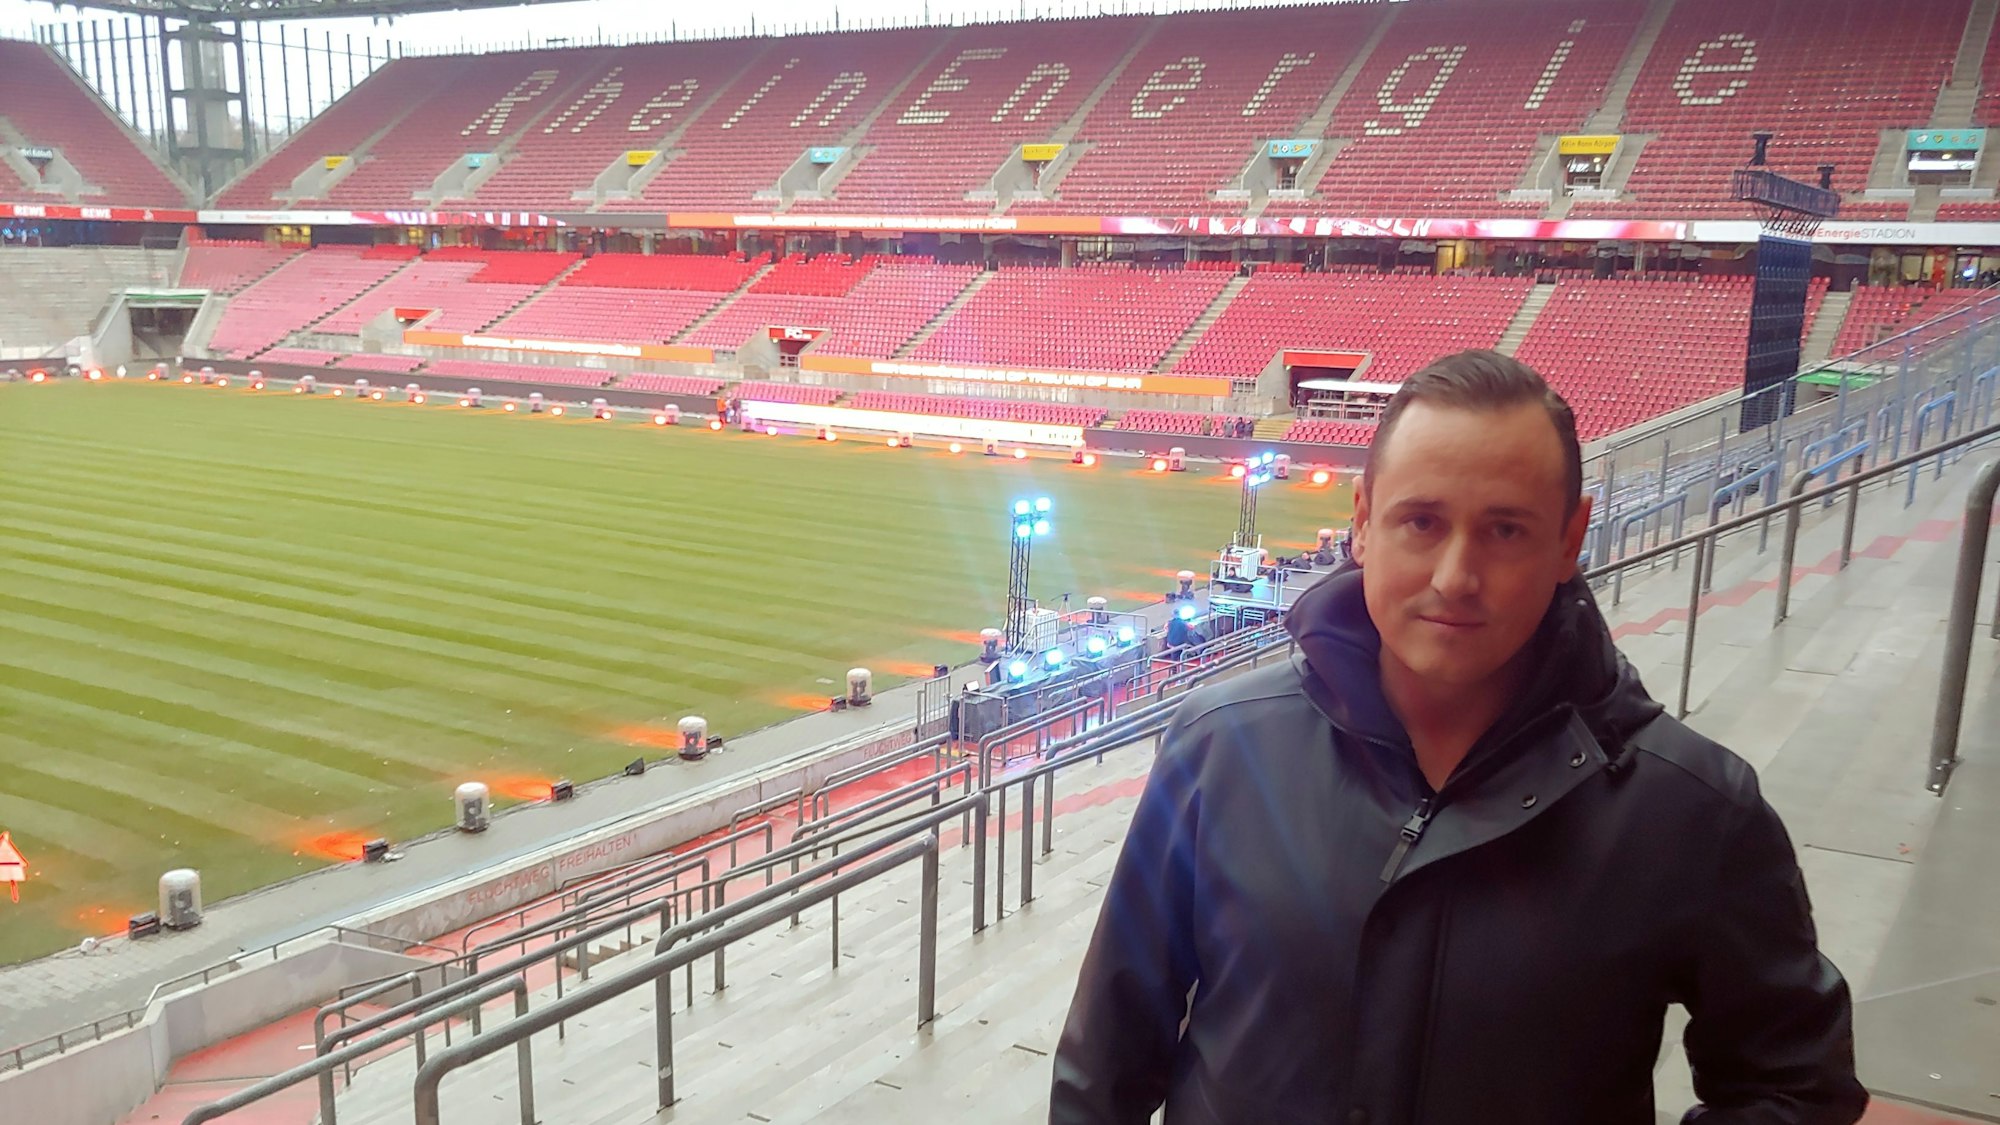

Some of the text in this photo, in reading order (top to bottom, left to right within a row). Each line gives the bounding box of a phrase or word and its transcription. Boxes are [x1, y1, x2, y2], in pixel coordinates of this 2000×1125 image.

[13, 205, 46, 217] REWE
[80, 207, 112, 219] REWE
[467, 866, 550, 905] FLUCHTWEG
[558, 836, 632, 872] FREIHALTEN
